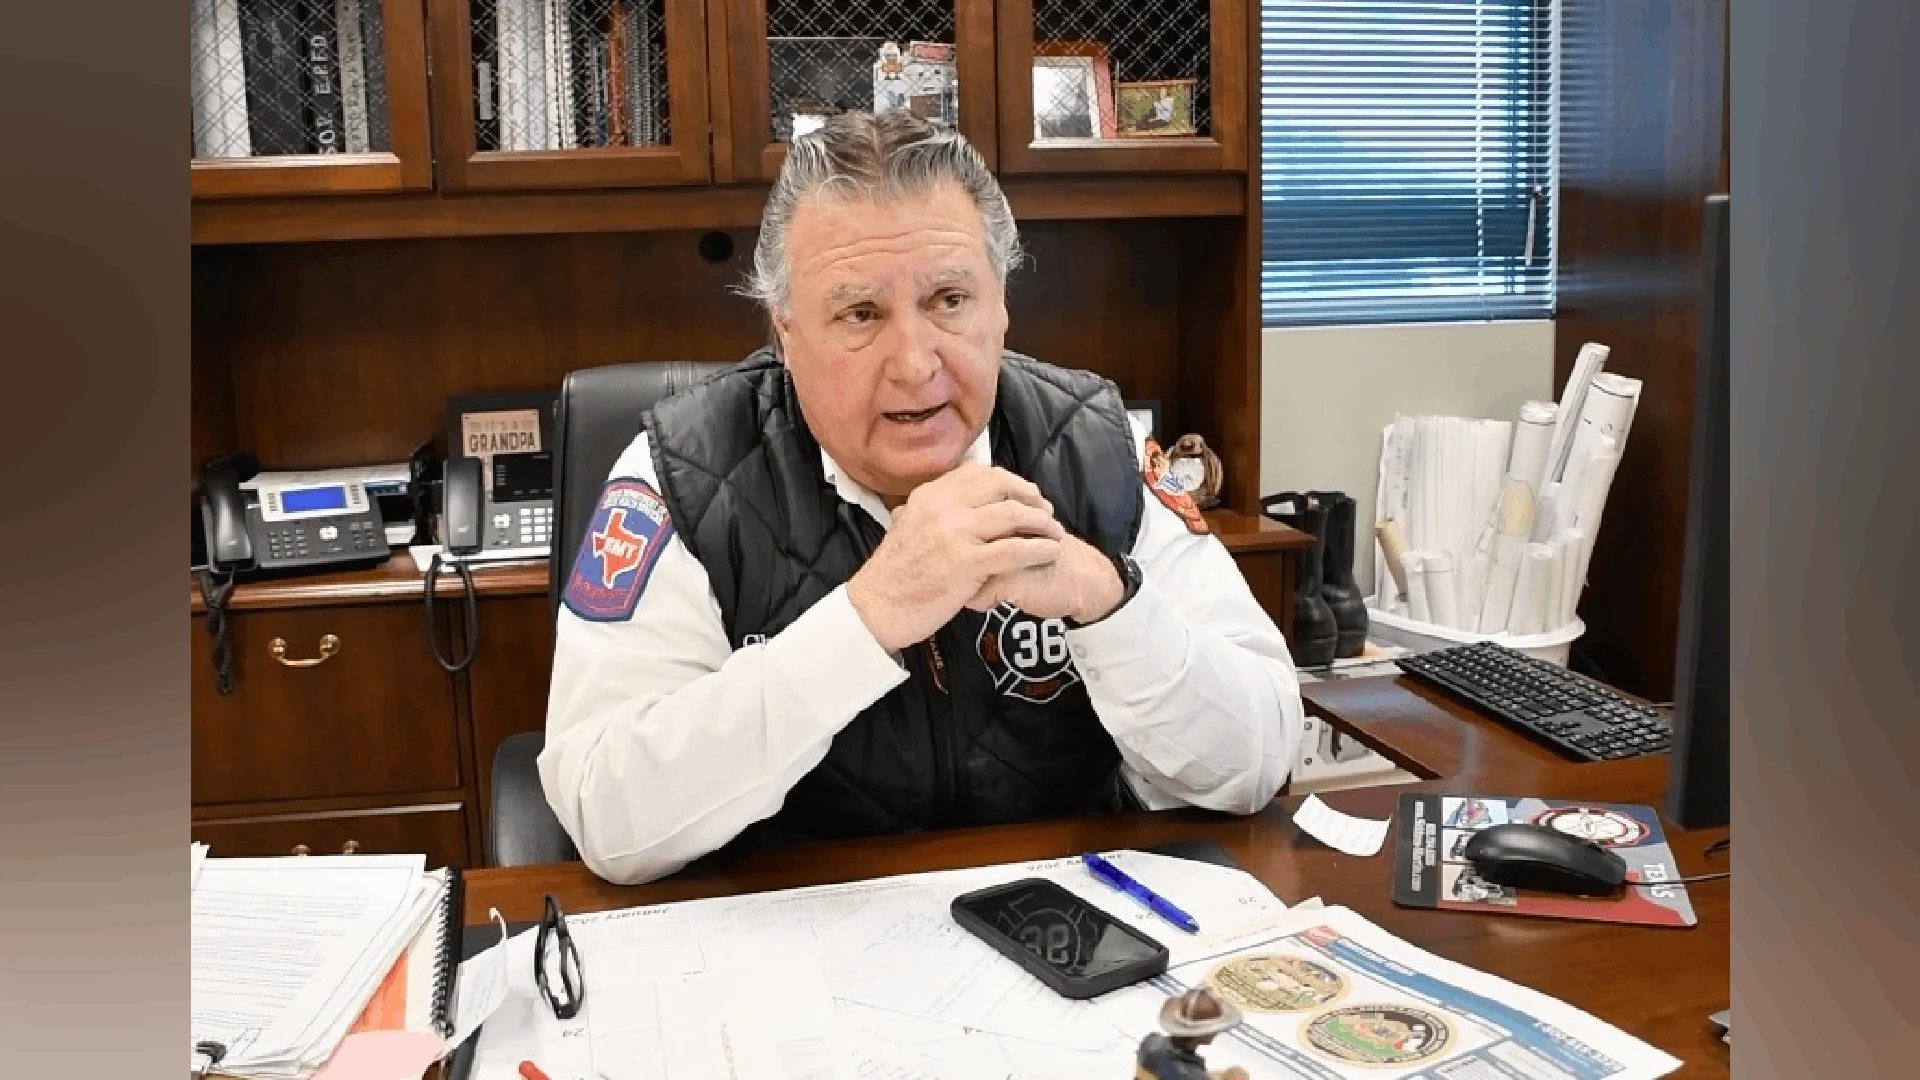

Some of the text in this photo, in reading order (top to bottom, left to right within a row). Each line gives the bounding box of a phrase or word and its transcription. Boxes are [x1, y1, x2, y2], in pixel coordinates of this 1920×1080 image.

[469, 431, 535, 453] GRANDPA
[604, 536, 640, 560] EMT
[1012, 618, 1067, 668] 36
